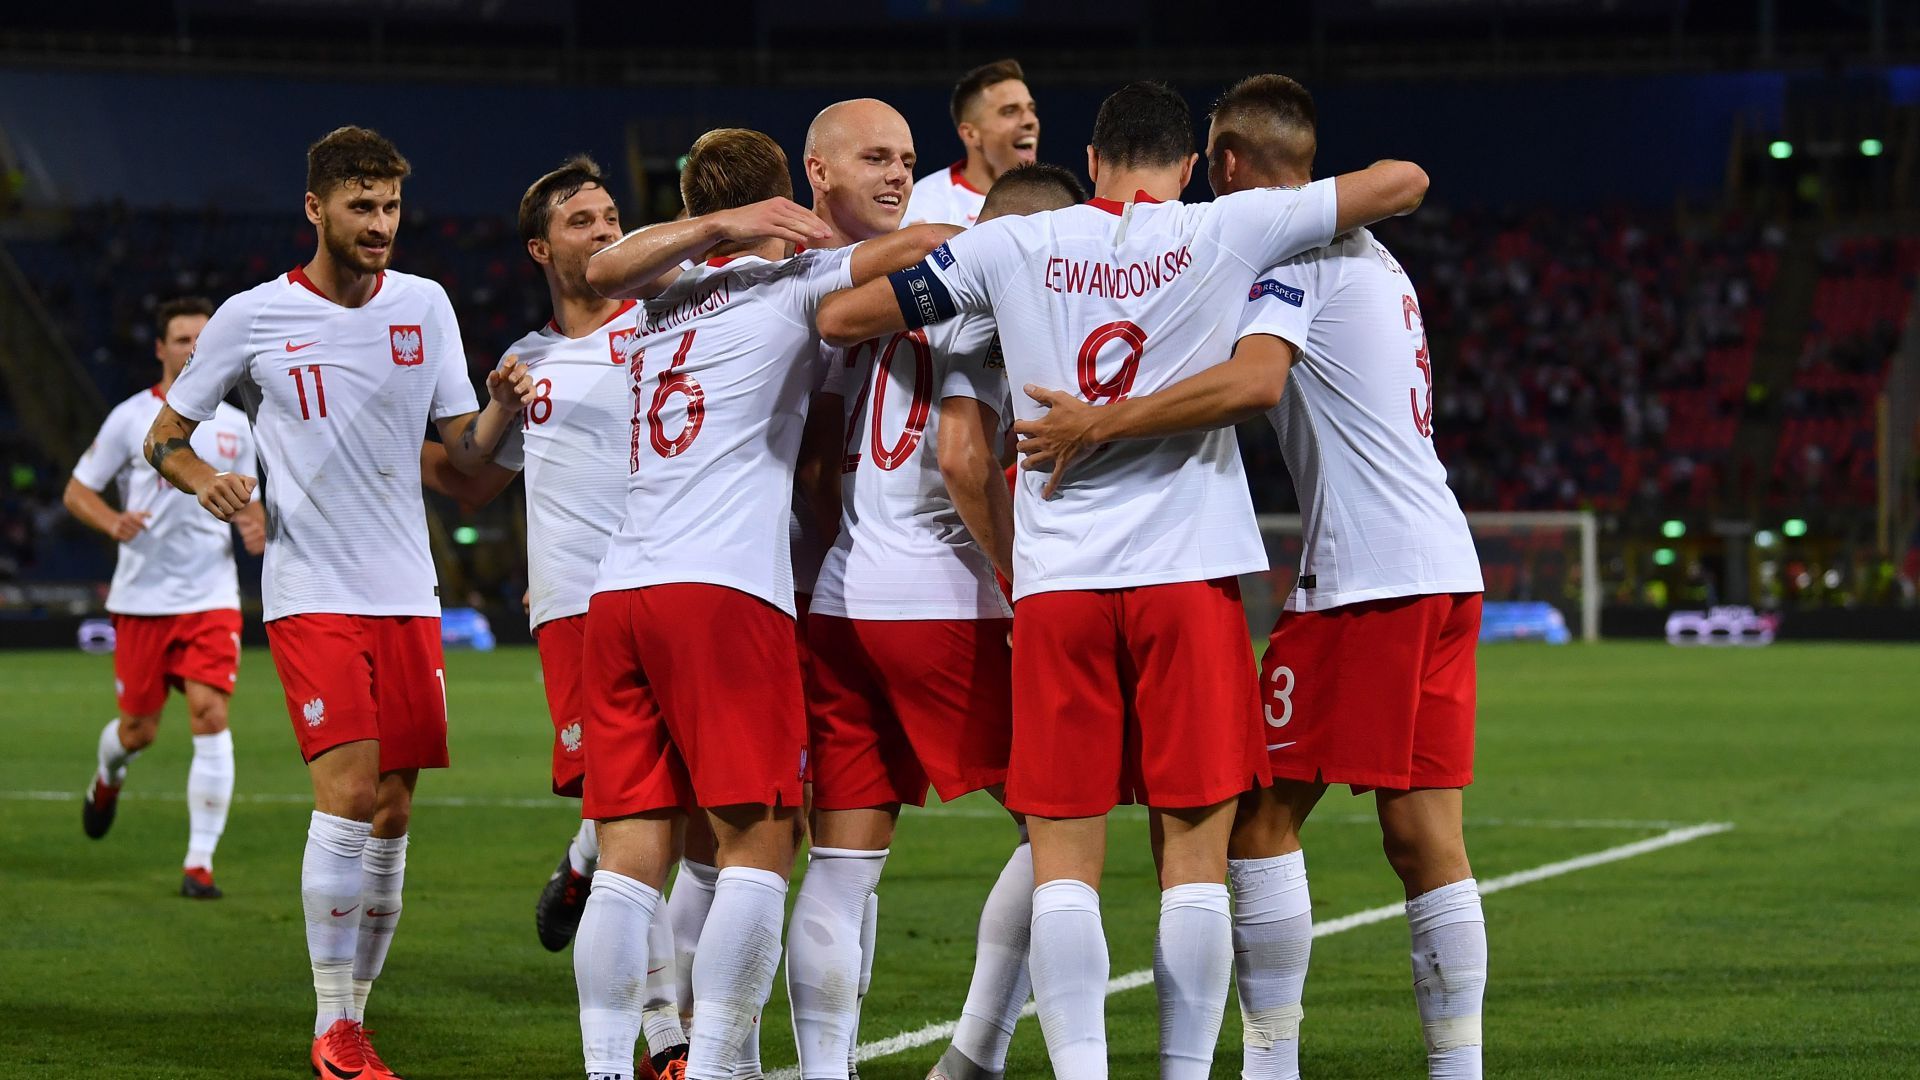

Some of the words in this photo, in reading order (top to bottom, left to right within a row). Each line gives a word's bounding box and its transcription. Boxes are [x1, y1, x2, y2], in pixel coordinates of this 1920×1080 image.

[1263, 283, 1302, 302] RESPECT
[288, 364, 327, 420] 11
[630, 330, 705, 475] 16
[842, 328, 933, 474] 20
[1077, 321, 1148, 404] 9
[1402, 294, 1432, 438] 3
[1264, 666, 1295, 728] 3
